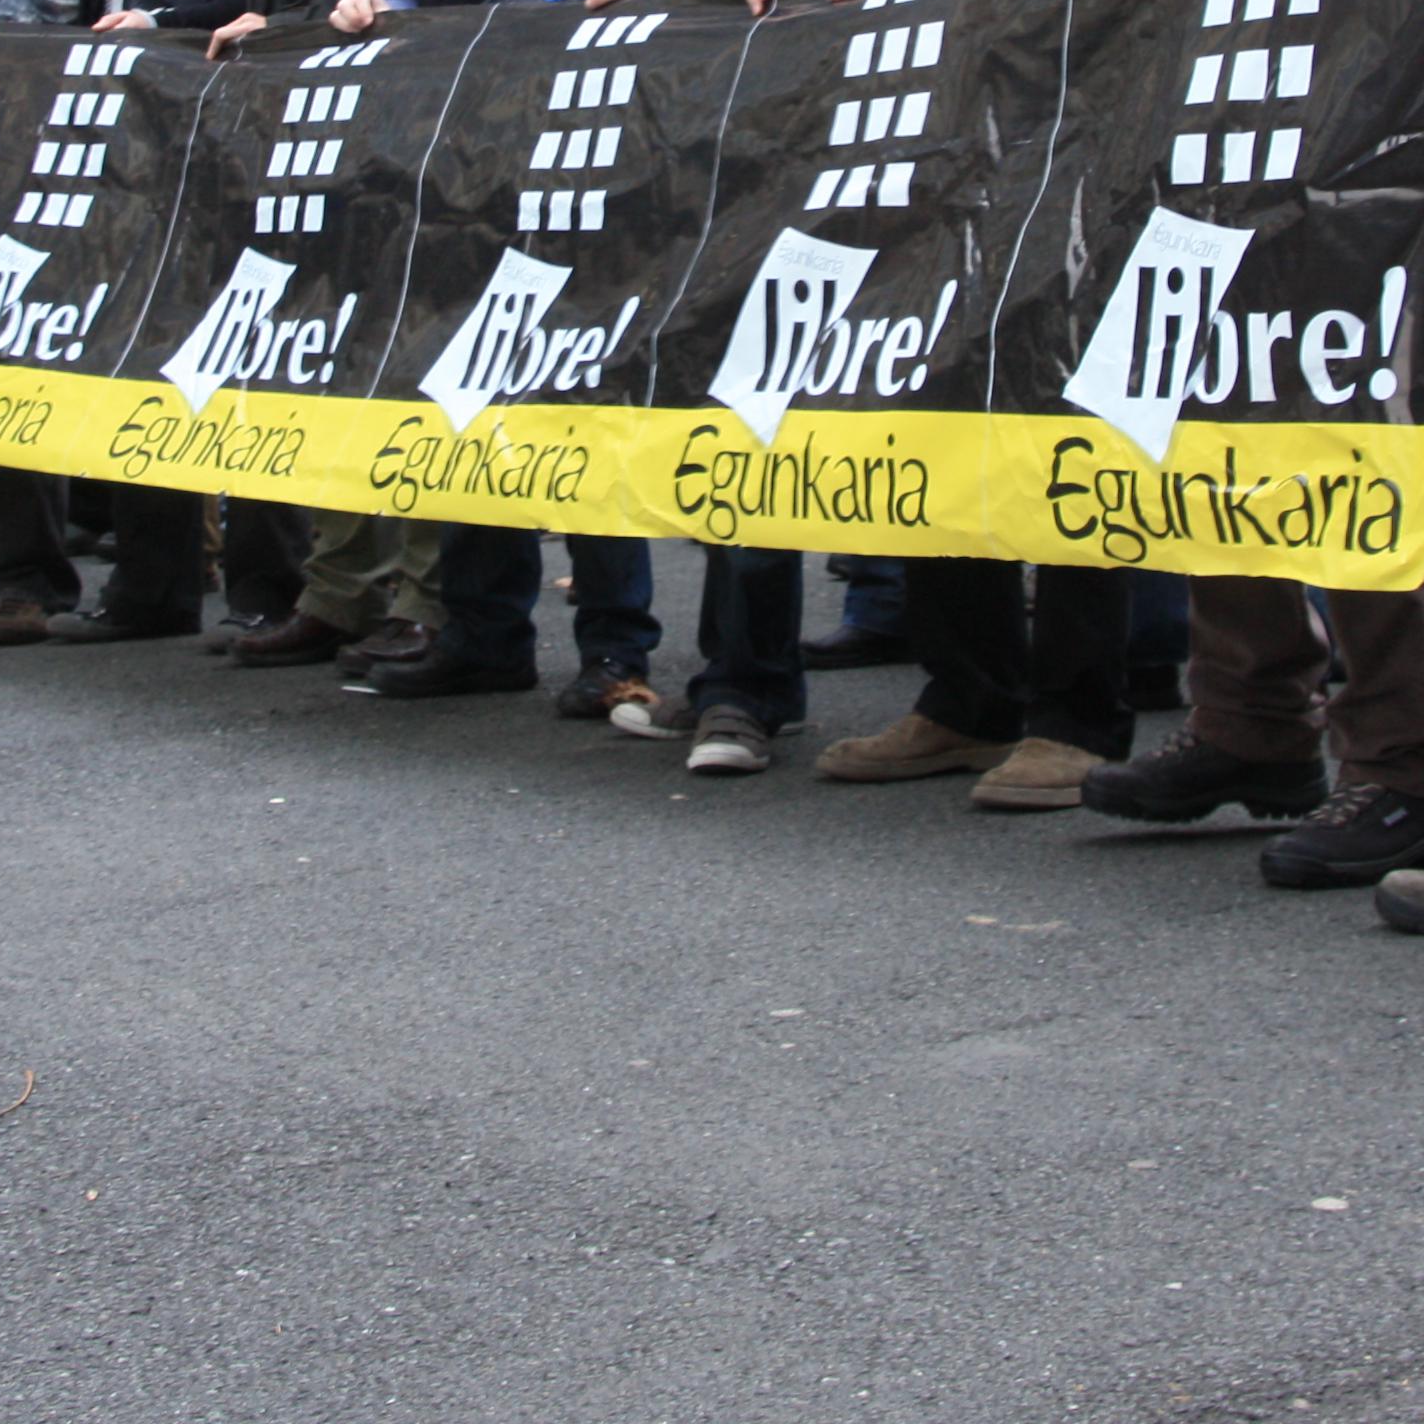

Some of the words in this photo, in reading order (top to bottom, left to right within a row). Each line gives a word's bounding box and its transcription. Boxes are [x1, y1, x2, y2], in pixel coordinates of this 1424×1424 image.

[196, 288, 358, 385] libre!
[457, 293, 641, 395] libre!
[753, 278, 958, 397] libre!
[1124, 264, 1407, 405] libre!
[108, 395, 306, 479] Egunkaria
[369, 415, 590, 513] Egunkaria
[675, 424, 931, 541] Egunkaria
[1046, 436, 1405, 564] Egunkaria
